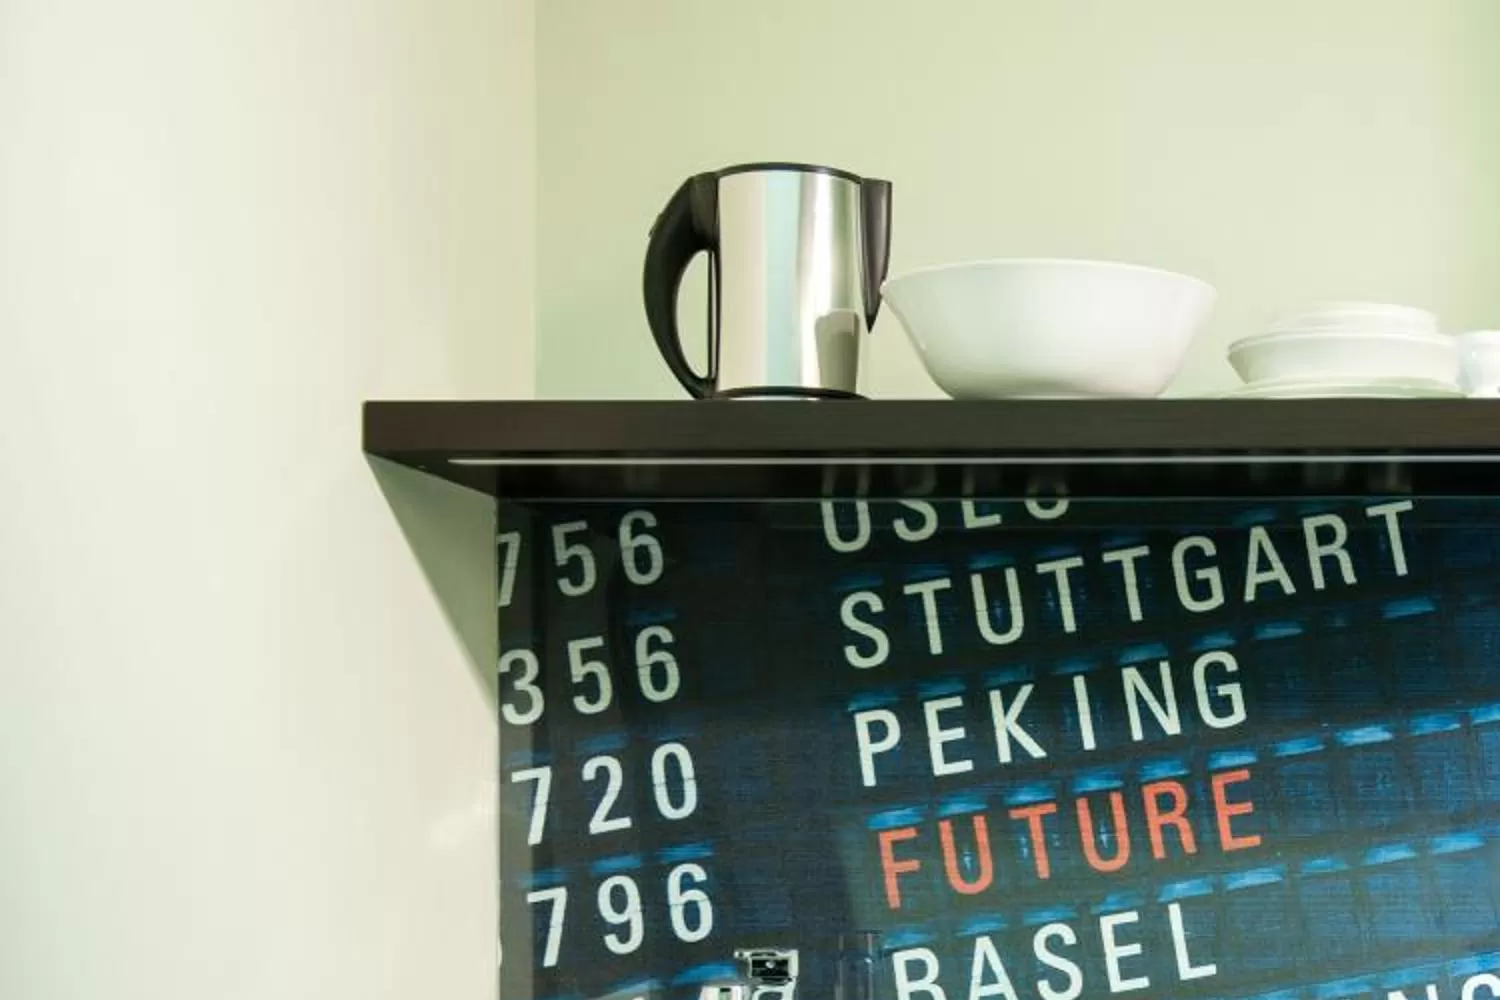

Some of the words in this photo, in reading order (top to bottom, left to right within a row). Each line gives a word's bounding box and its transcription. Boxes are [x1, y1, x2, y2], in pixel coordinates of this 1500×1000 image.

[497, 510, 664, 607] 756
[821, 498, 1070, 551] OSL
[840, 500, 1414, 669] STUTTGART
[499, 625, 680, 726] 356
[854, 650, 1248, 787] PEKING
[510, 742, 699, 847] 720
[878, 769, 1262, 910] FUTURE
[497, 863, 714, 968] 796
